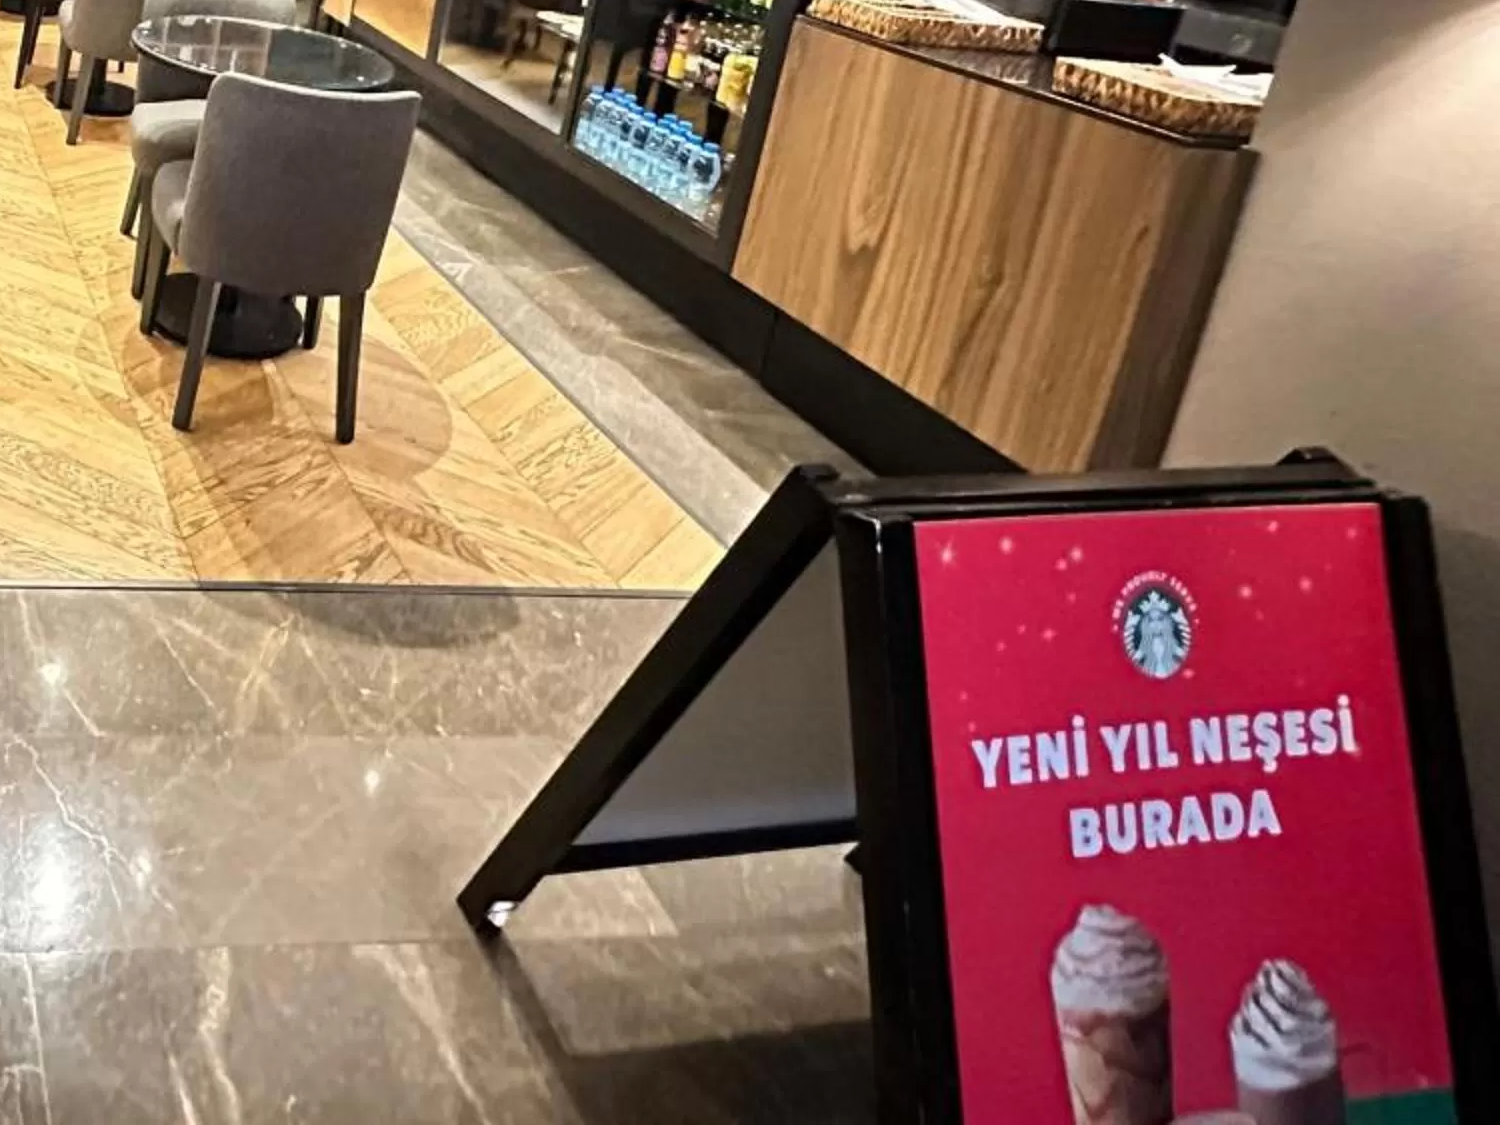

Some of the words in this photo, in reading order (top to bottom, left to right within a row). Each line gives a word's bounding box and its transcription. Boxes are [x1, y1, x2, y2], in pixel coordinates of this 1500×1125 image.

[971, 714, 1089, 789] YENİ
[1100, 720, 1179, 773] YIL
[1190, 694, 1359, 773] NEŞESİ
[1069, 789, 1281, 859] BURADA
